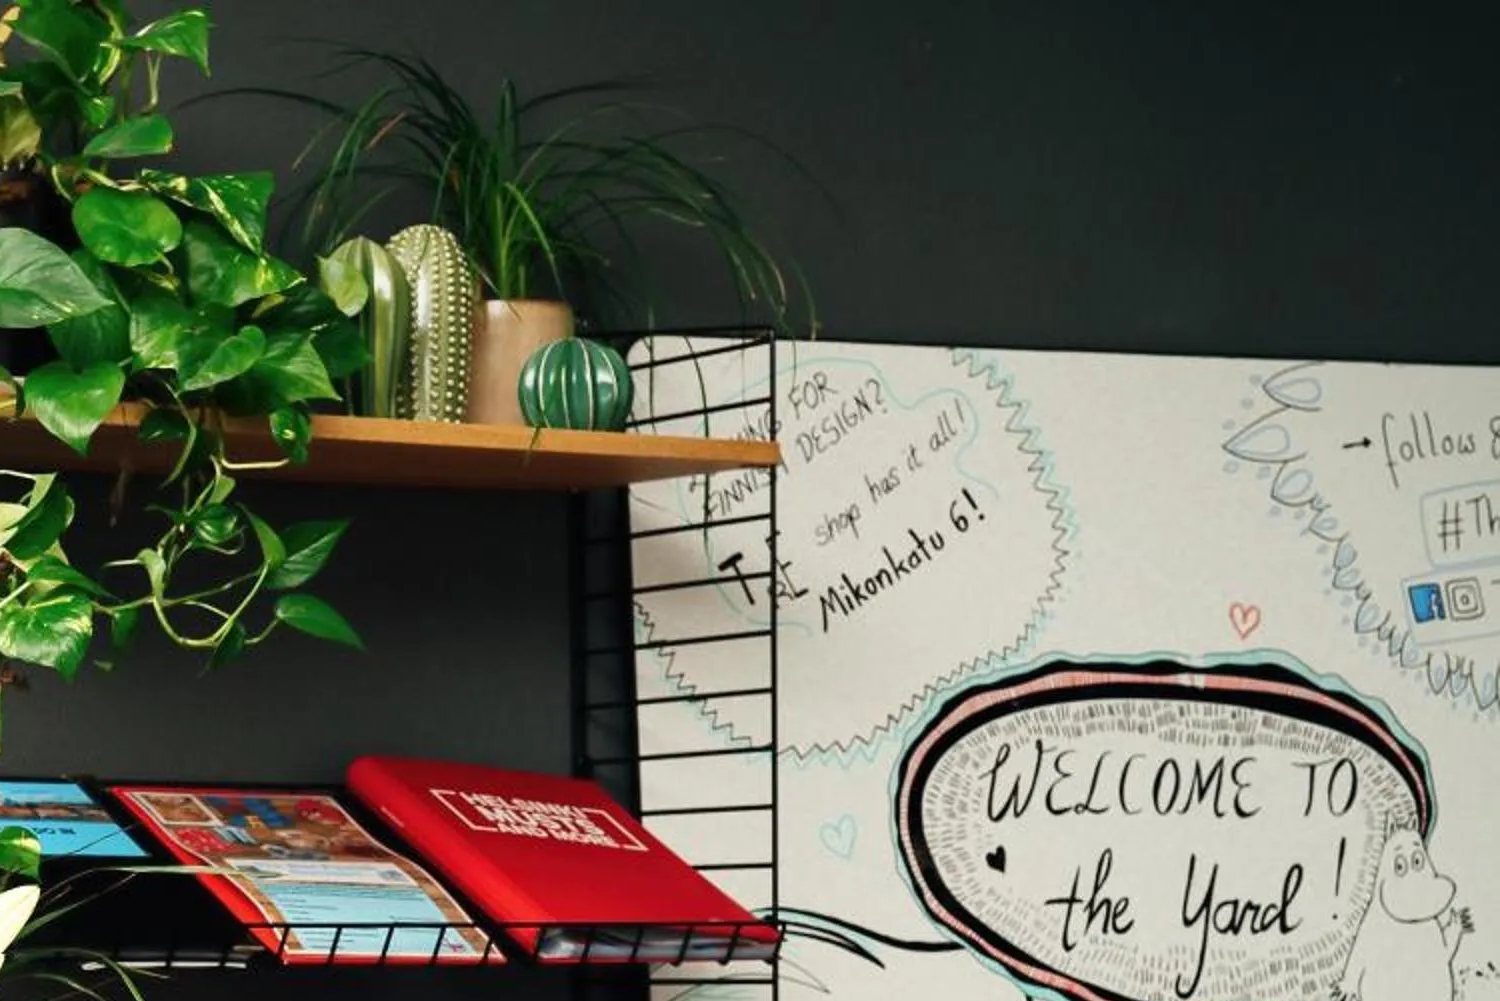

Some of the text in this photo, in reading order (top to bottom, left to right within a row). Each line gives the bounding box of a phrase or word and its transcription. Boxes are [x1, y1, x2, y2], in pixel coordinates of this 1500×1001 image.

[797, 377, 888, 464] DESIGN?
[1382, 411, 1476, 489] follow
[814, 502, 861, 547] shop
[864, 466, 902, 505] has
[906, 438, 924, 472] it
[819, 485, 987, 633] Mikonkatu 6!
[979, 740, 1360, 823] WELCOME TO
[1044, 847, 1135, 953] the
[1176, 853, 1303, 999] Yard
